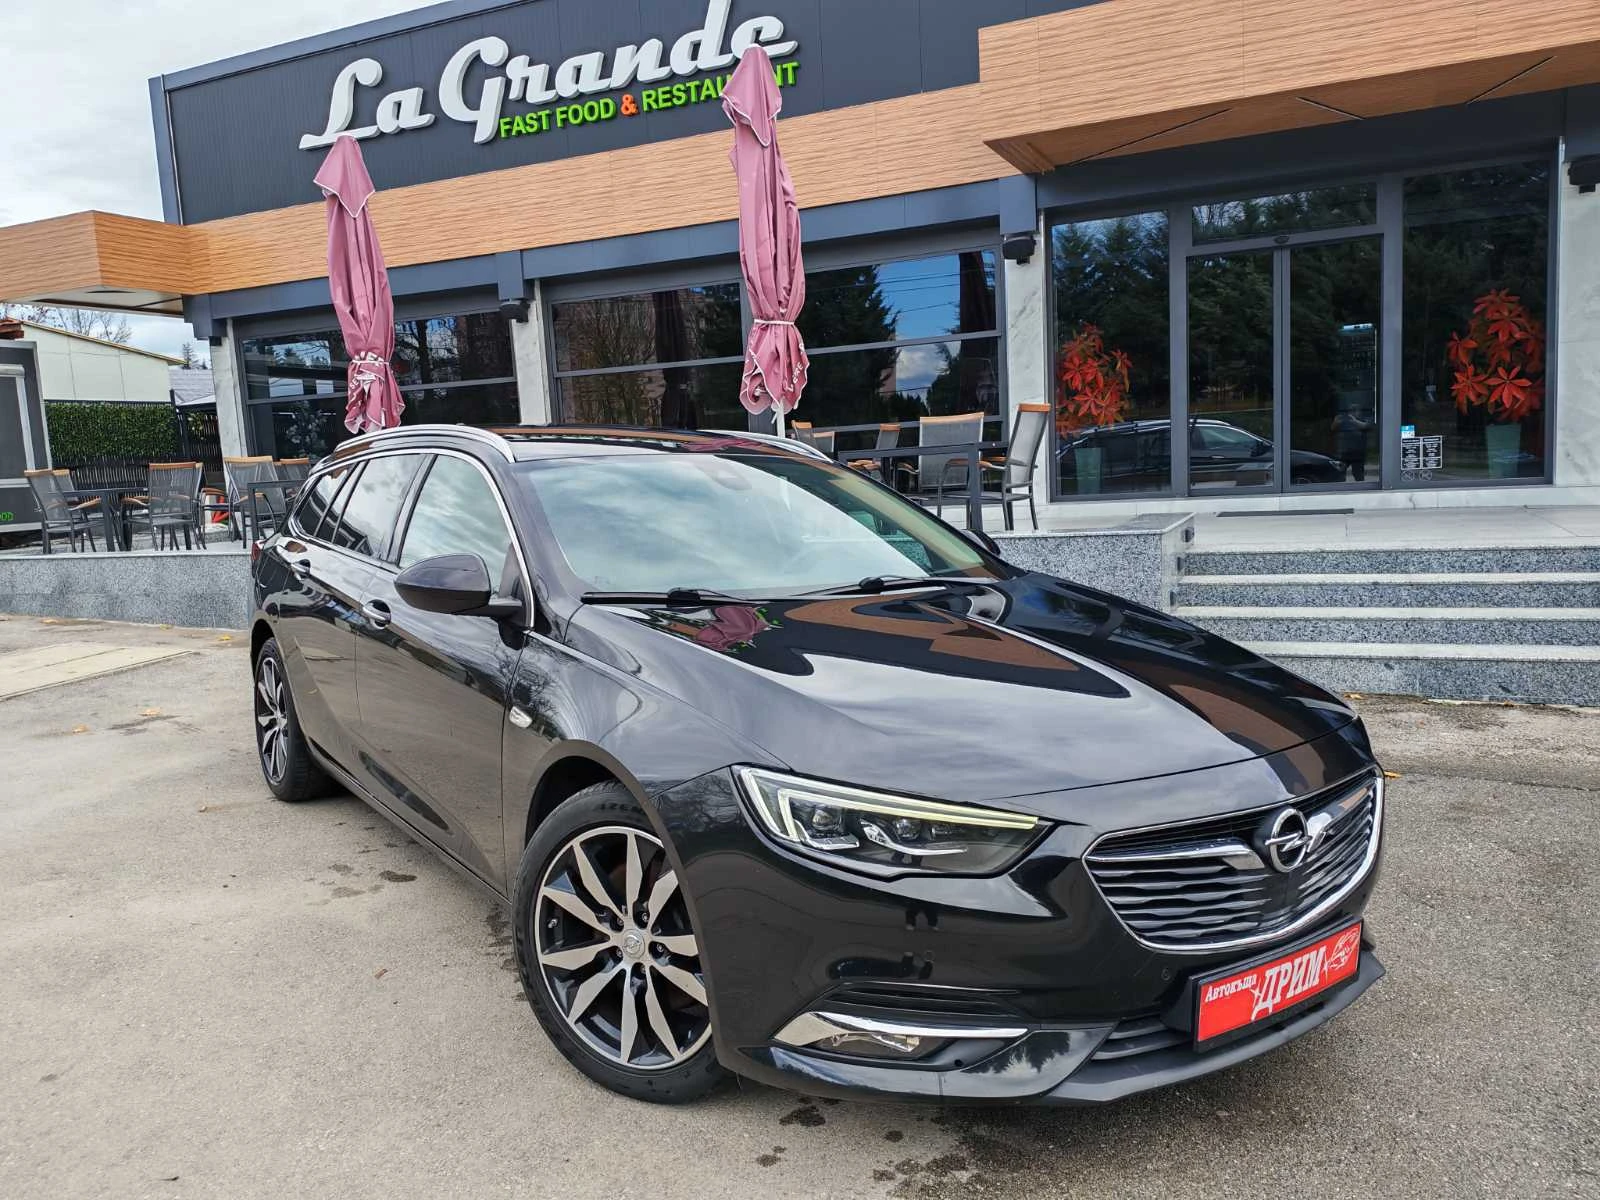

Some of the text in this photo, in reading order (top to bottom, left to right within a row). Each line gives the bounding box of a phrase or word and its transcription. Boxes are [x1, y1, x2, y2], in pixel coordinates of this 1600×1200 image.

[299, 0, 798, 150] La Grande
[500, 109, 551, 138] FAST
[556, 98, 617, 128] FOOD
[620, 93, 637, 116] &
[1251, 945, 1327, 1021] ДРИМ
